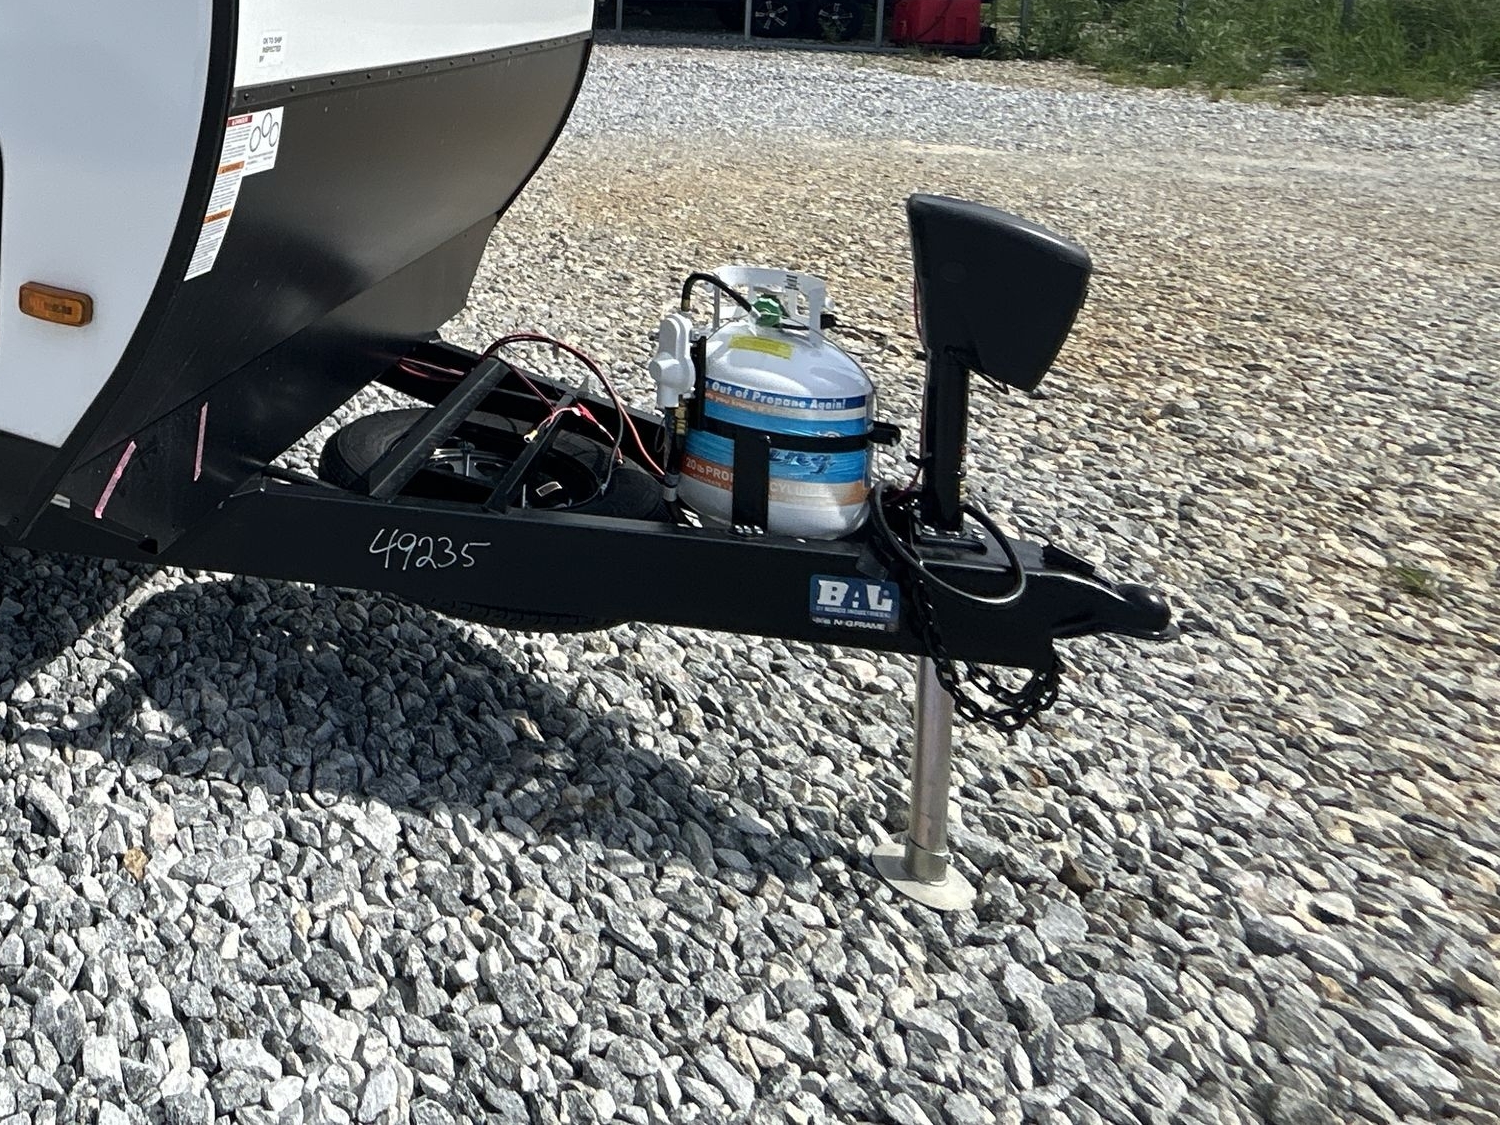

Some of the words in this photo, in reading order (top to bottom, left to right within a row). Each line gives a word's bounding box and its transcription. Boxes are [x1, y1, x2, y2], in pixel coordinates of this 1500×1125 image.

[712, 380, 732, 394] Out
[735, 388, 749, 400] of
[752, 390, 806, 409] Propane
[810, 398, 846, 411] Again!
[685, 456, 696, 470] 20
[369, 528, 491, 570] 49235
[817, 579, 893, 612] BAL
